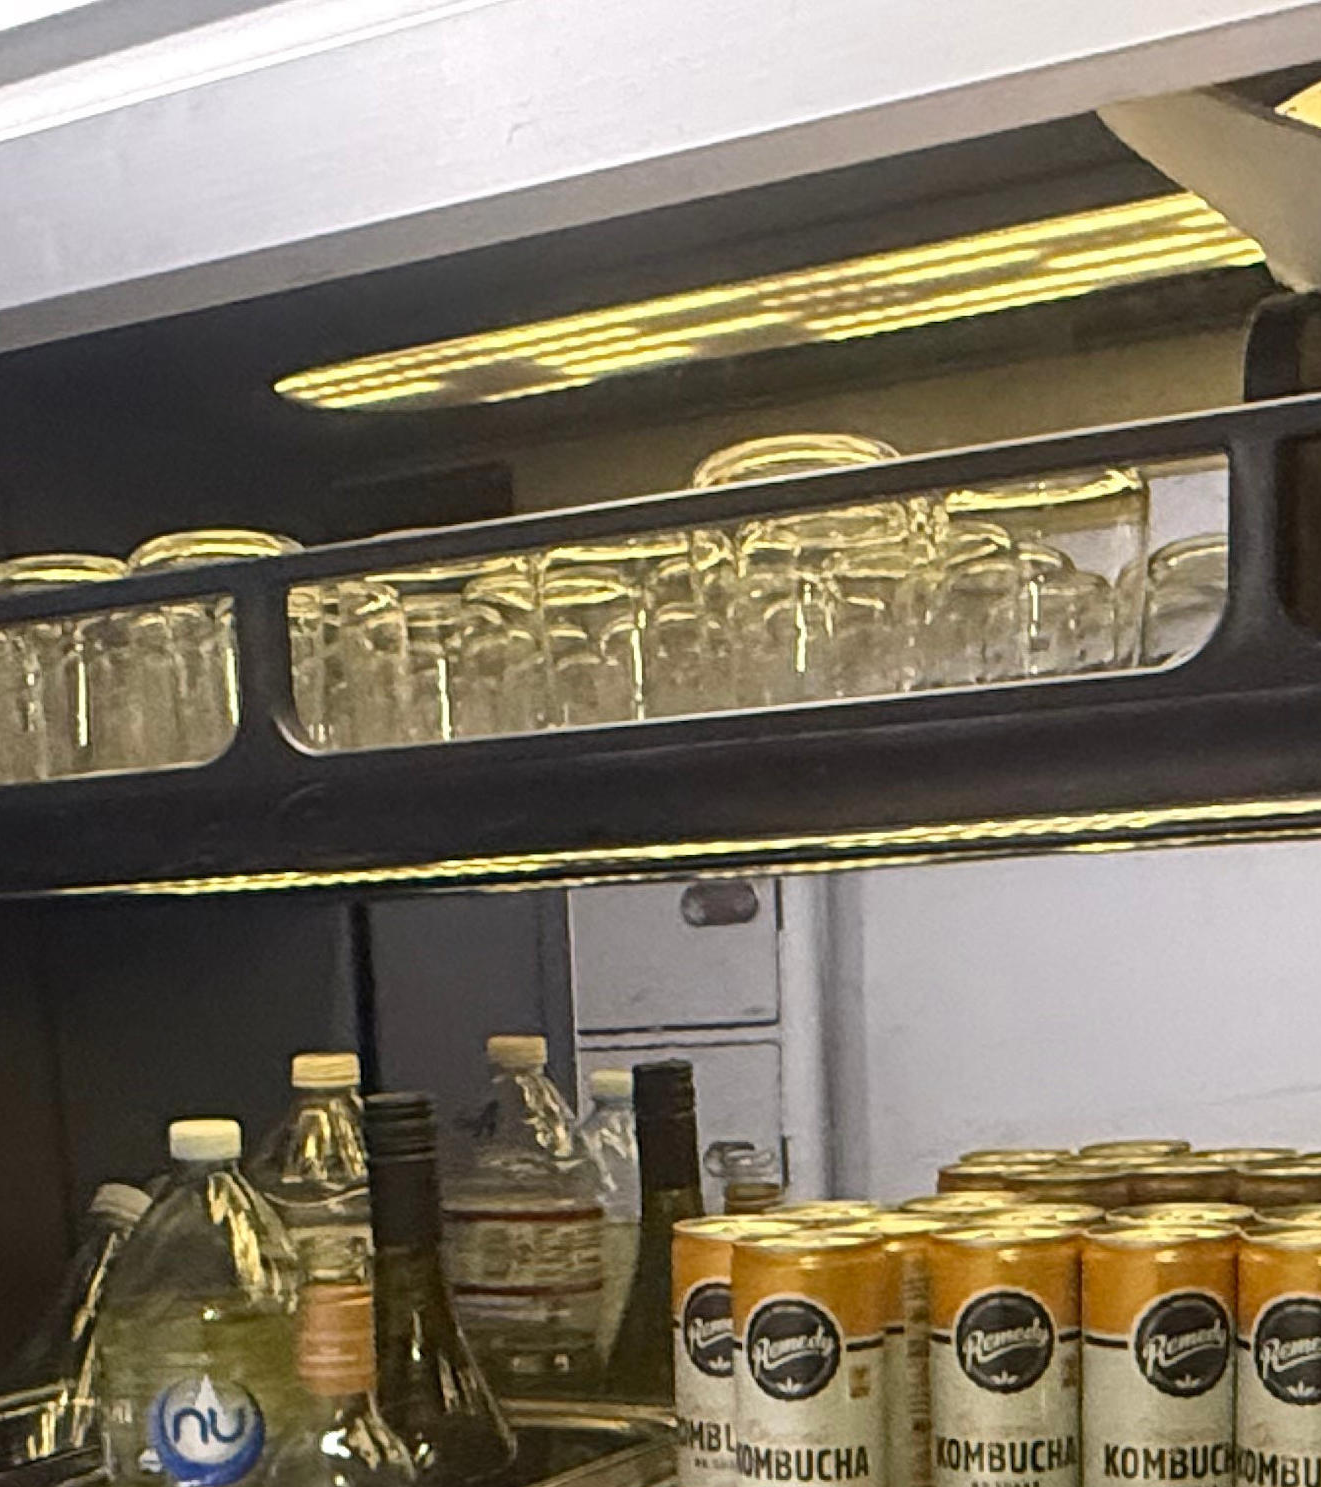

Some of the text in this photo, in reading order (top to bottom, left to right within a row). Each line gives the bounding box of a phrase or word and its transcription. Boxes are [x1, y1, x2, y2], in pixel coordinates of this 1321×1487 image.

[753, 1325, 835, 1378] Remedy
[962, 1316, 1050, 1373] Remedy
[935, 1436, 1077, 1475] KOMBUCHA
